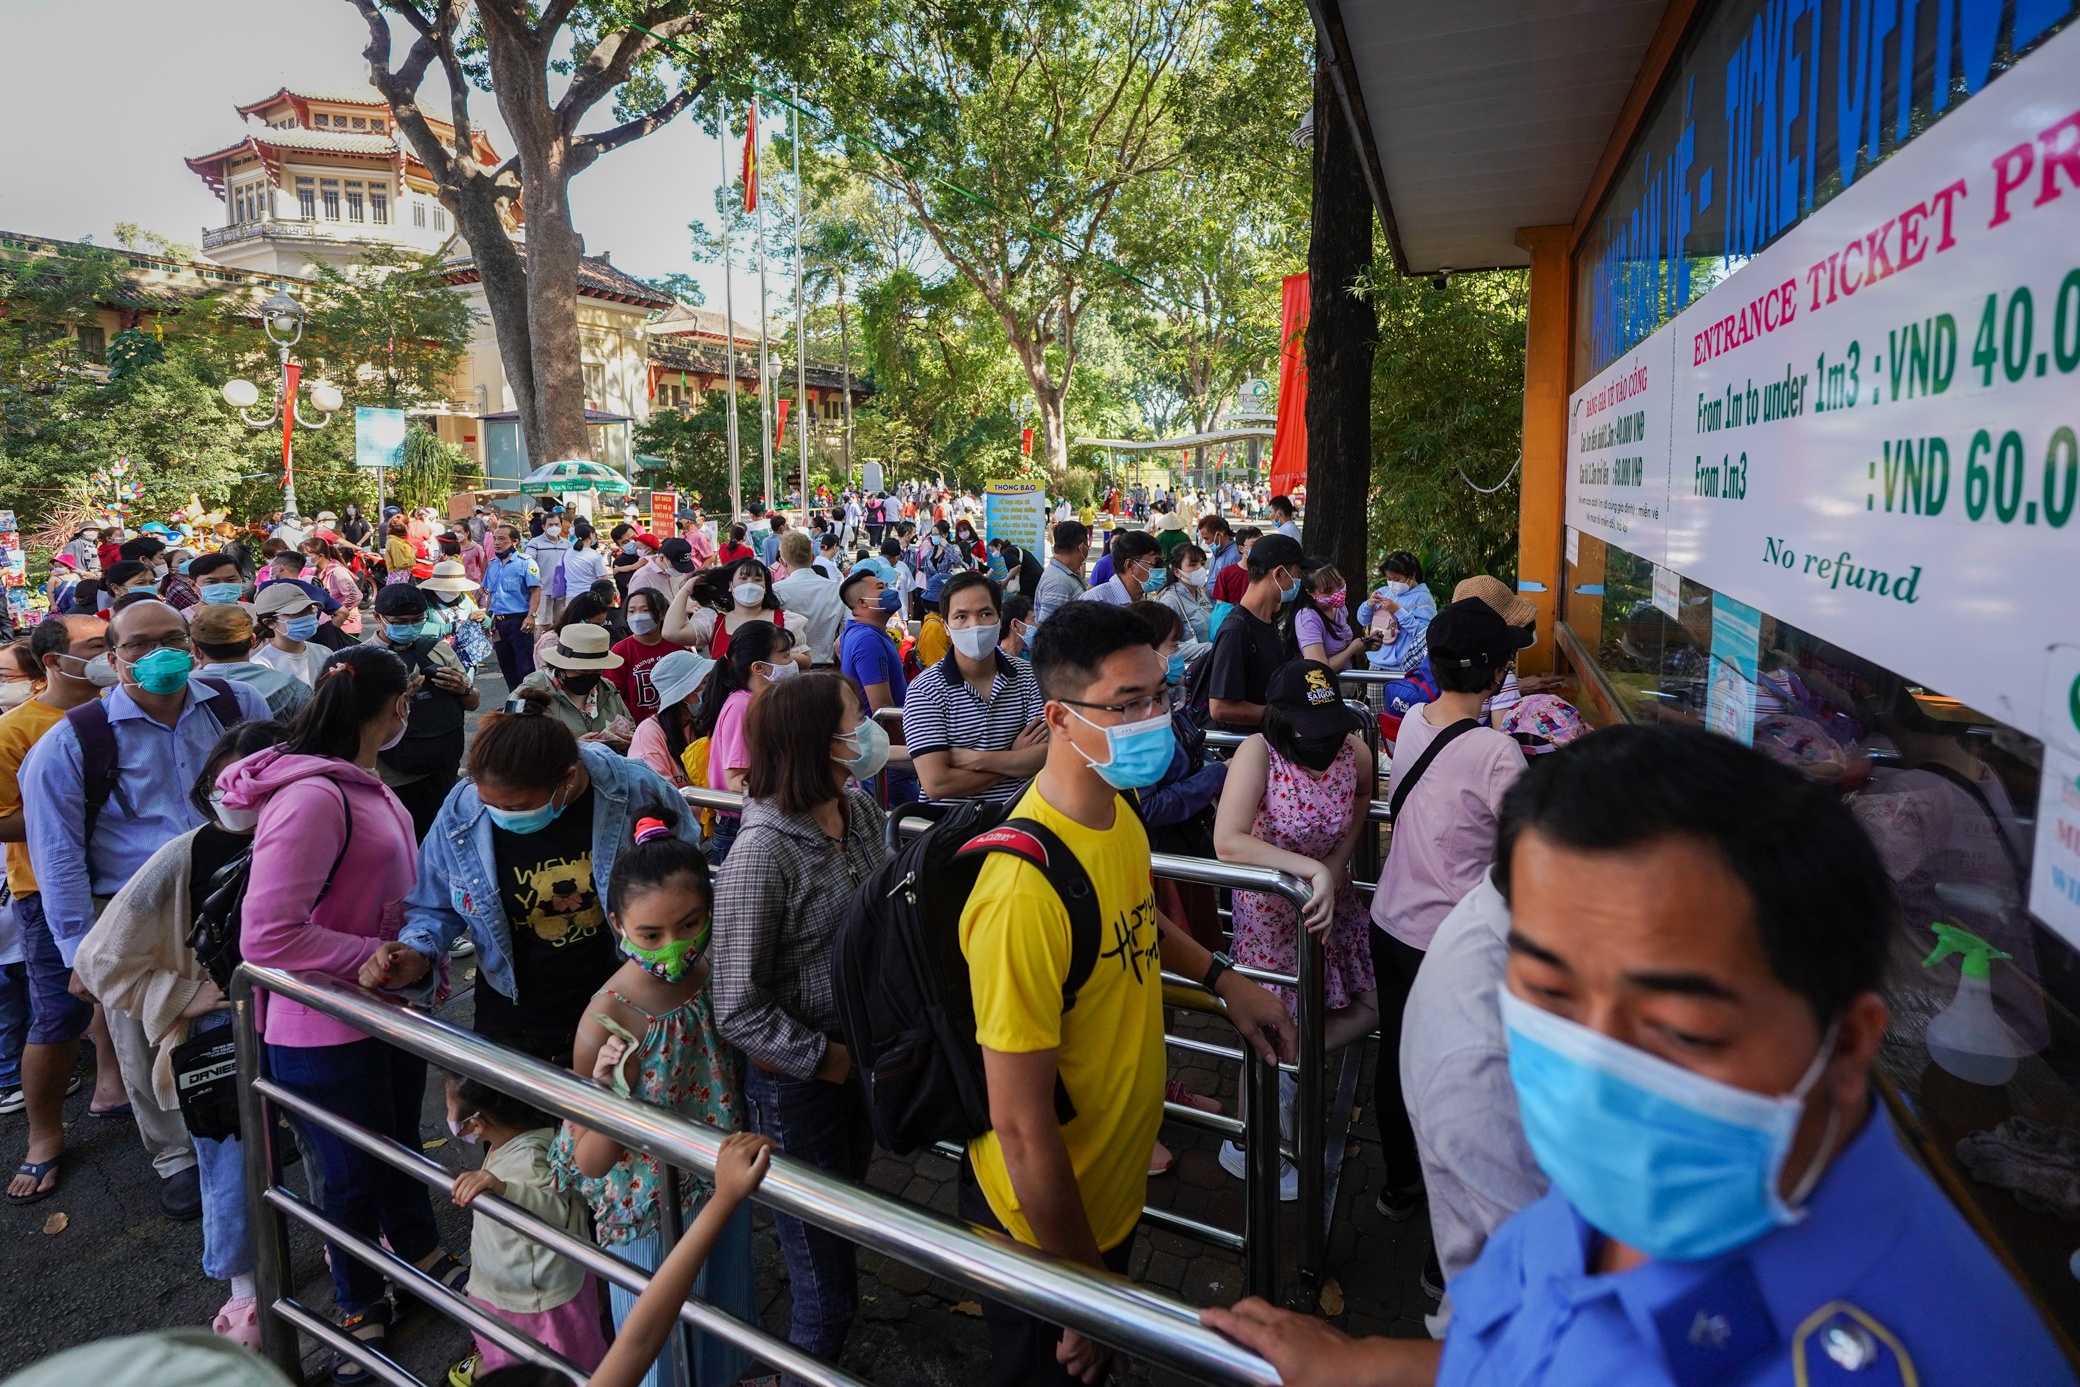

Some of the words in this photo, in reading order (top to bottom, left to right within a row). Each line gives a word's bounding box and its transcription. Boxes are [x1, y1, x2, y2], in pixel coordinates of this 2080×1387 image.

[1666, 73, 1695, 317] VÉ
[1724, 0, 1822, 271] TICKET
[1692, 277, 1797, 367] ENTRANCE
[1806, 178, 1968, 313] TICKET
[1607, 383, 1615, 407] VÉ
[1615, 377, 1628, 404] VÀO
[1628, 356, 1648, 398] CỔNG
[1696, 391, 1722, 435] From
[1725, 386, 1744, 429] 1m
[1746, 384, 1759, 425] to
[1762, 363, 1808, 423] under
[1814, 340, 1862, 414] 1m3
[994, 483, 1018, 491] THÔNG
[1020, 483, 1036, 491] BÁO
[1694, 454, 1721, 499] From
[1722, 451, 1748, 501] 1m3
[1651, 507, 1659, 520] vé
[1762, 536, 1796, 569] No
[1803, 549, 1923, 604] refund
[1307, 688, 1336, 701] SAIGON
